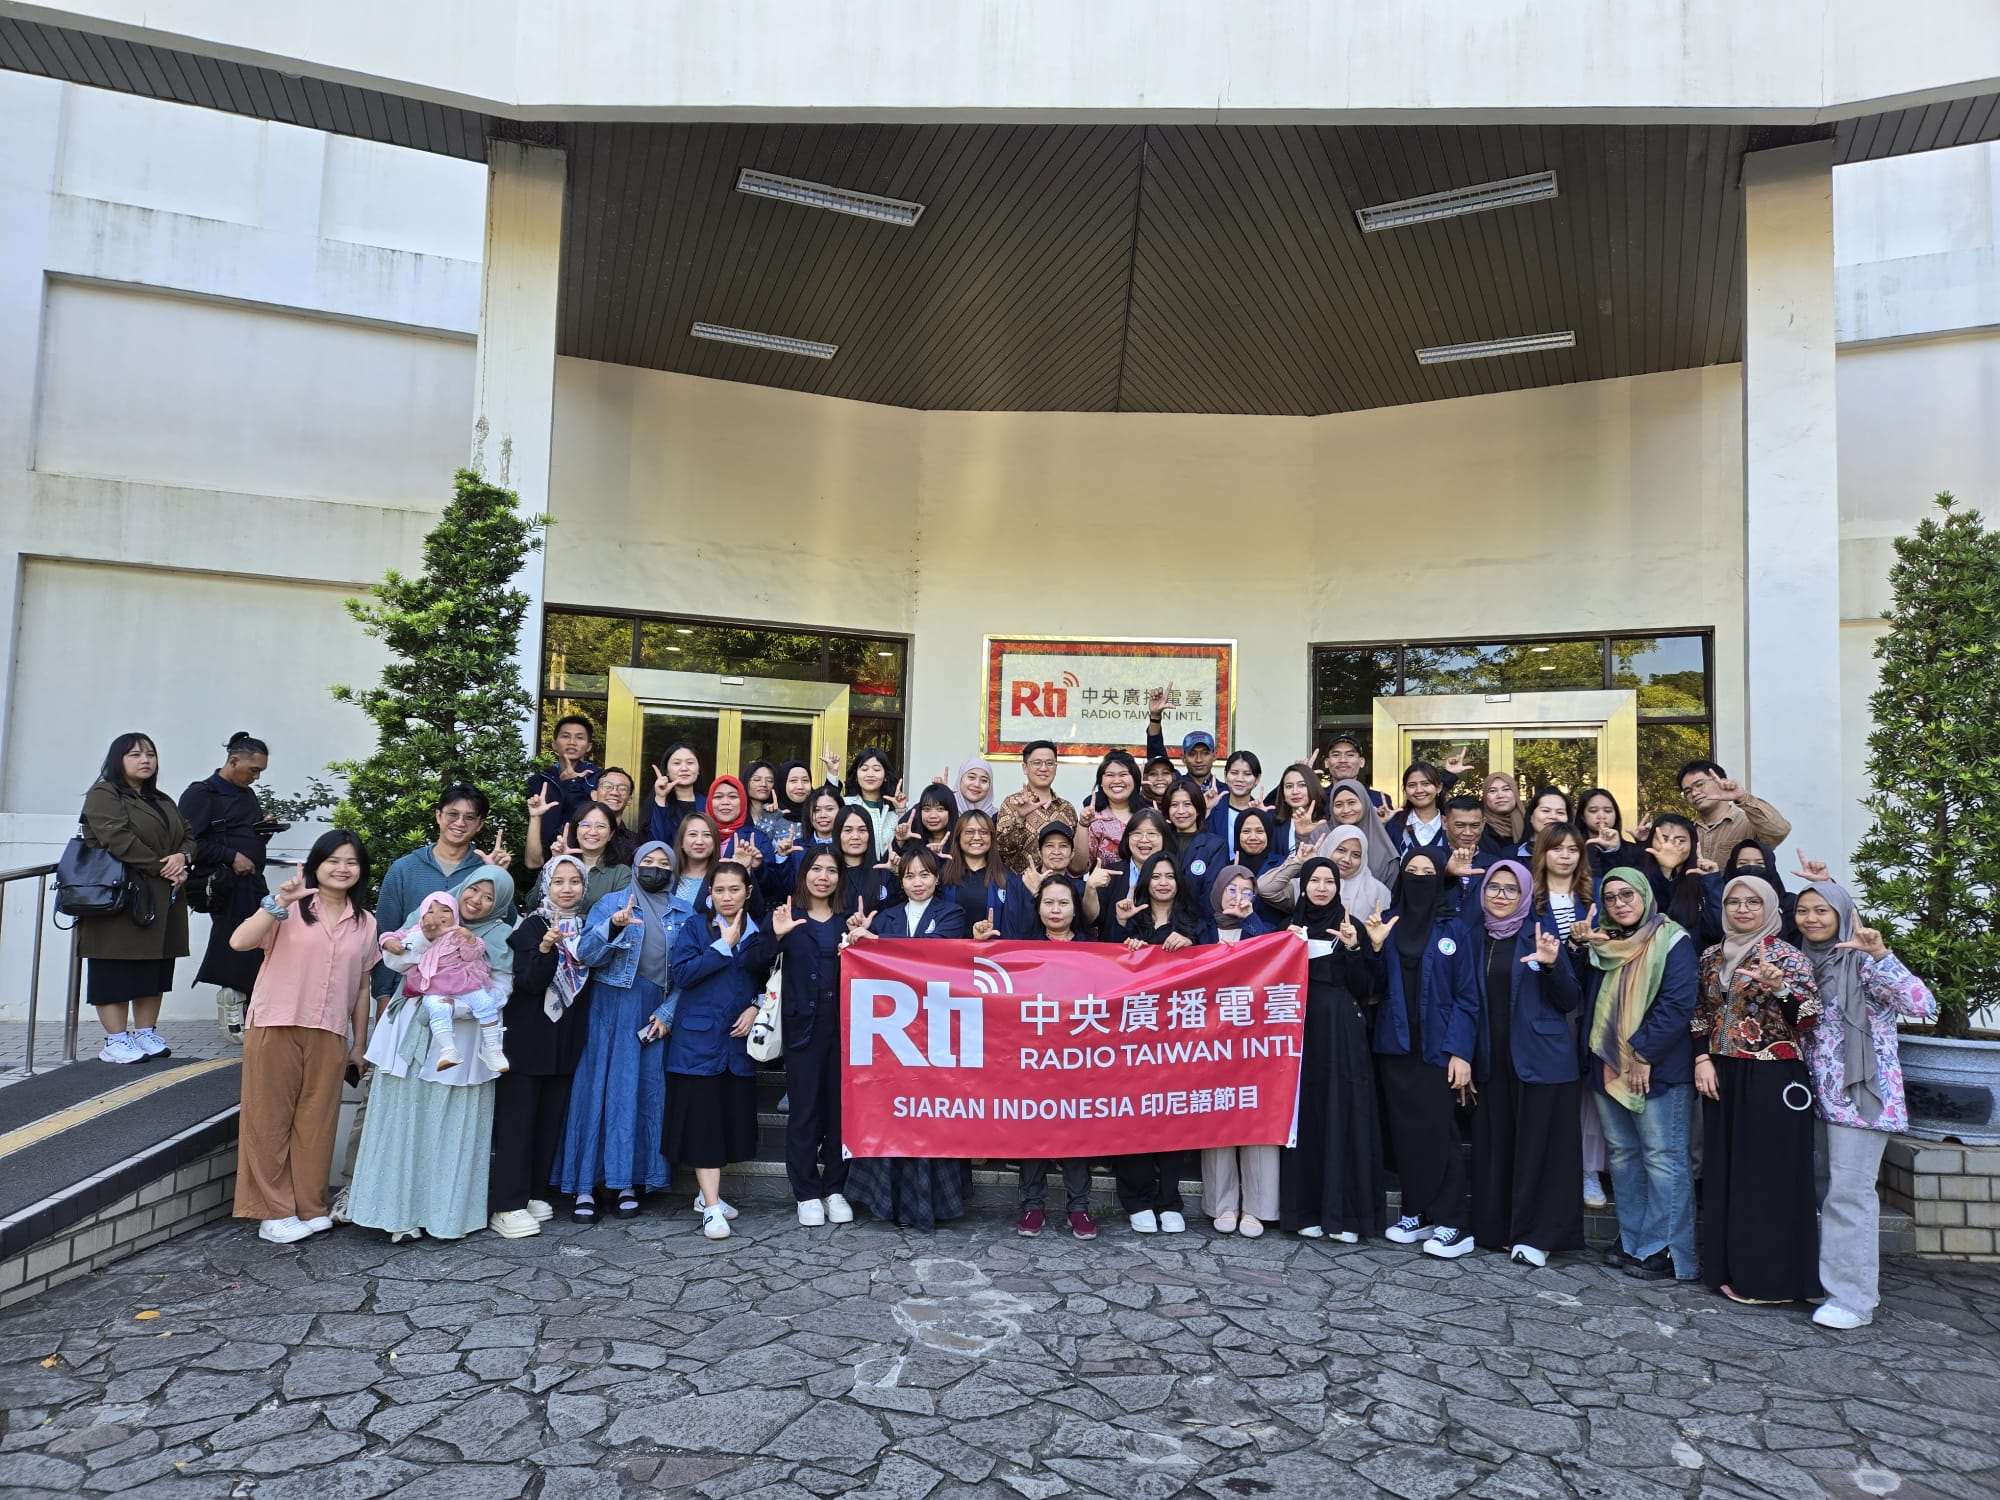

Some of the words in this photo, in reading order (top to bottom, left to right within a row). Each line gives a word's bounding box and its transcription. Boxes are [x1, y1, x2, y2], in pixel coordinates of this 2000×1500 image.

[1011, 681, 1068, 718] Rti
[1081, 709, 1121, 719] RADIO
[1123, 710, 1171, 720] TAIWN
[1176, 711, 1202, 721] INTL
[849, 978, 984, 1069] Rti
[1020, 982, 1302, 1037] 中央廣播電臺
[1019, 1045, 1115, 1070] RADIO
[1120, 1038, 1232, 1067] TAIWAN
[1242, 1034, 1303, 1060] INTL
[893, 1096, 985, 1120] SIARAN
[992, 1096, 1135, 1120] INDONESIA
[1140, 1085, 1258, 1118] 印尼語節目
